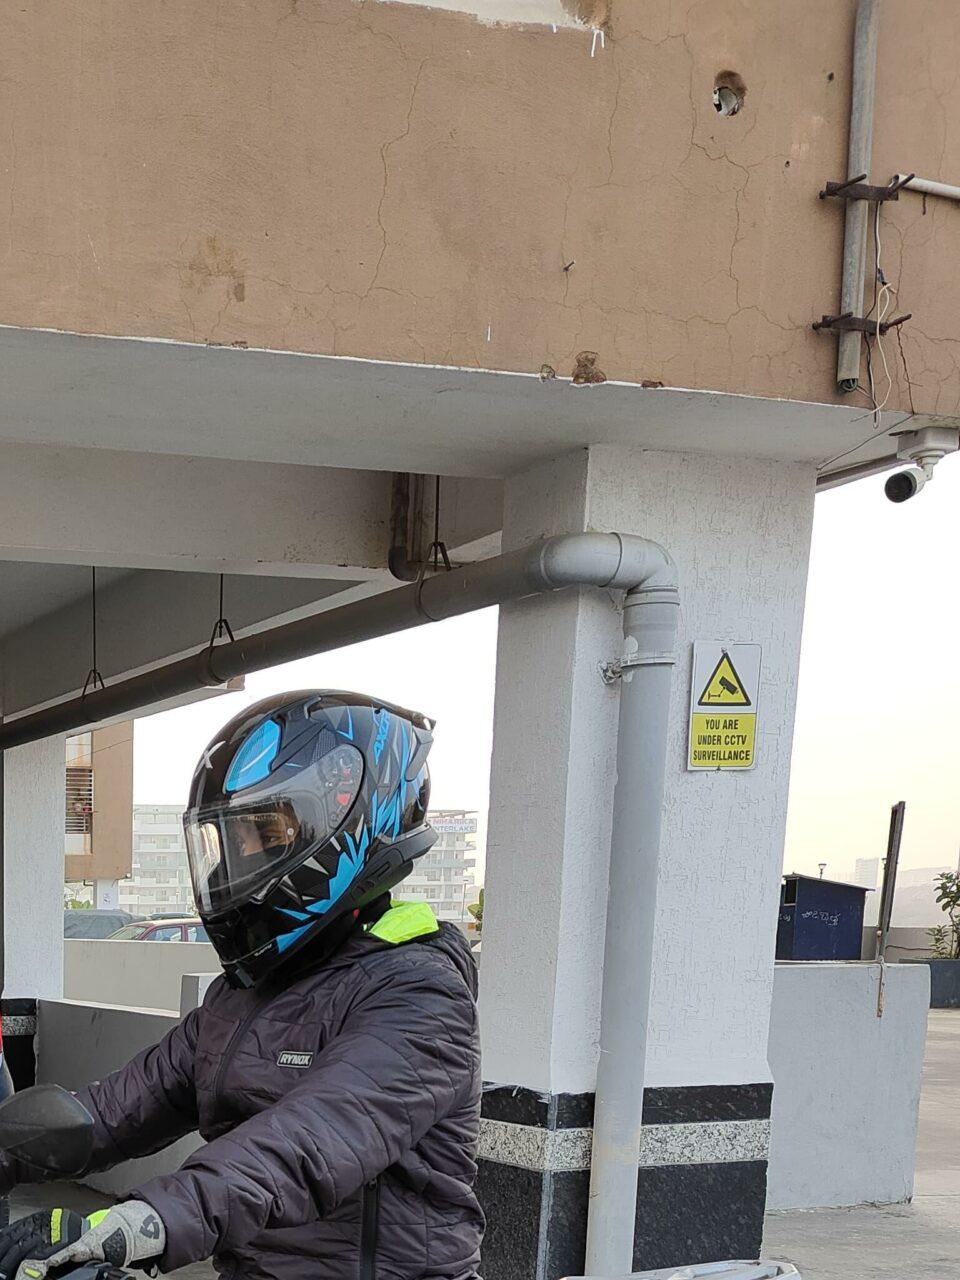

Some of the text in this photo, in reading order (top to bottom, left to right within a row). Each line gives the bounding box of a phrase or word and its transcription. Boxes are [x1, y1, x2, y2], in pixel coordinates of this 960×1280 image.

[706, 719, 739, 730] YOU ARE
[698, 735, 747, 745] UNDER CCTV
[693, 750, 751, 761] SURVEILLANCE
